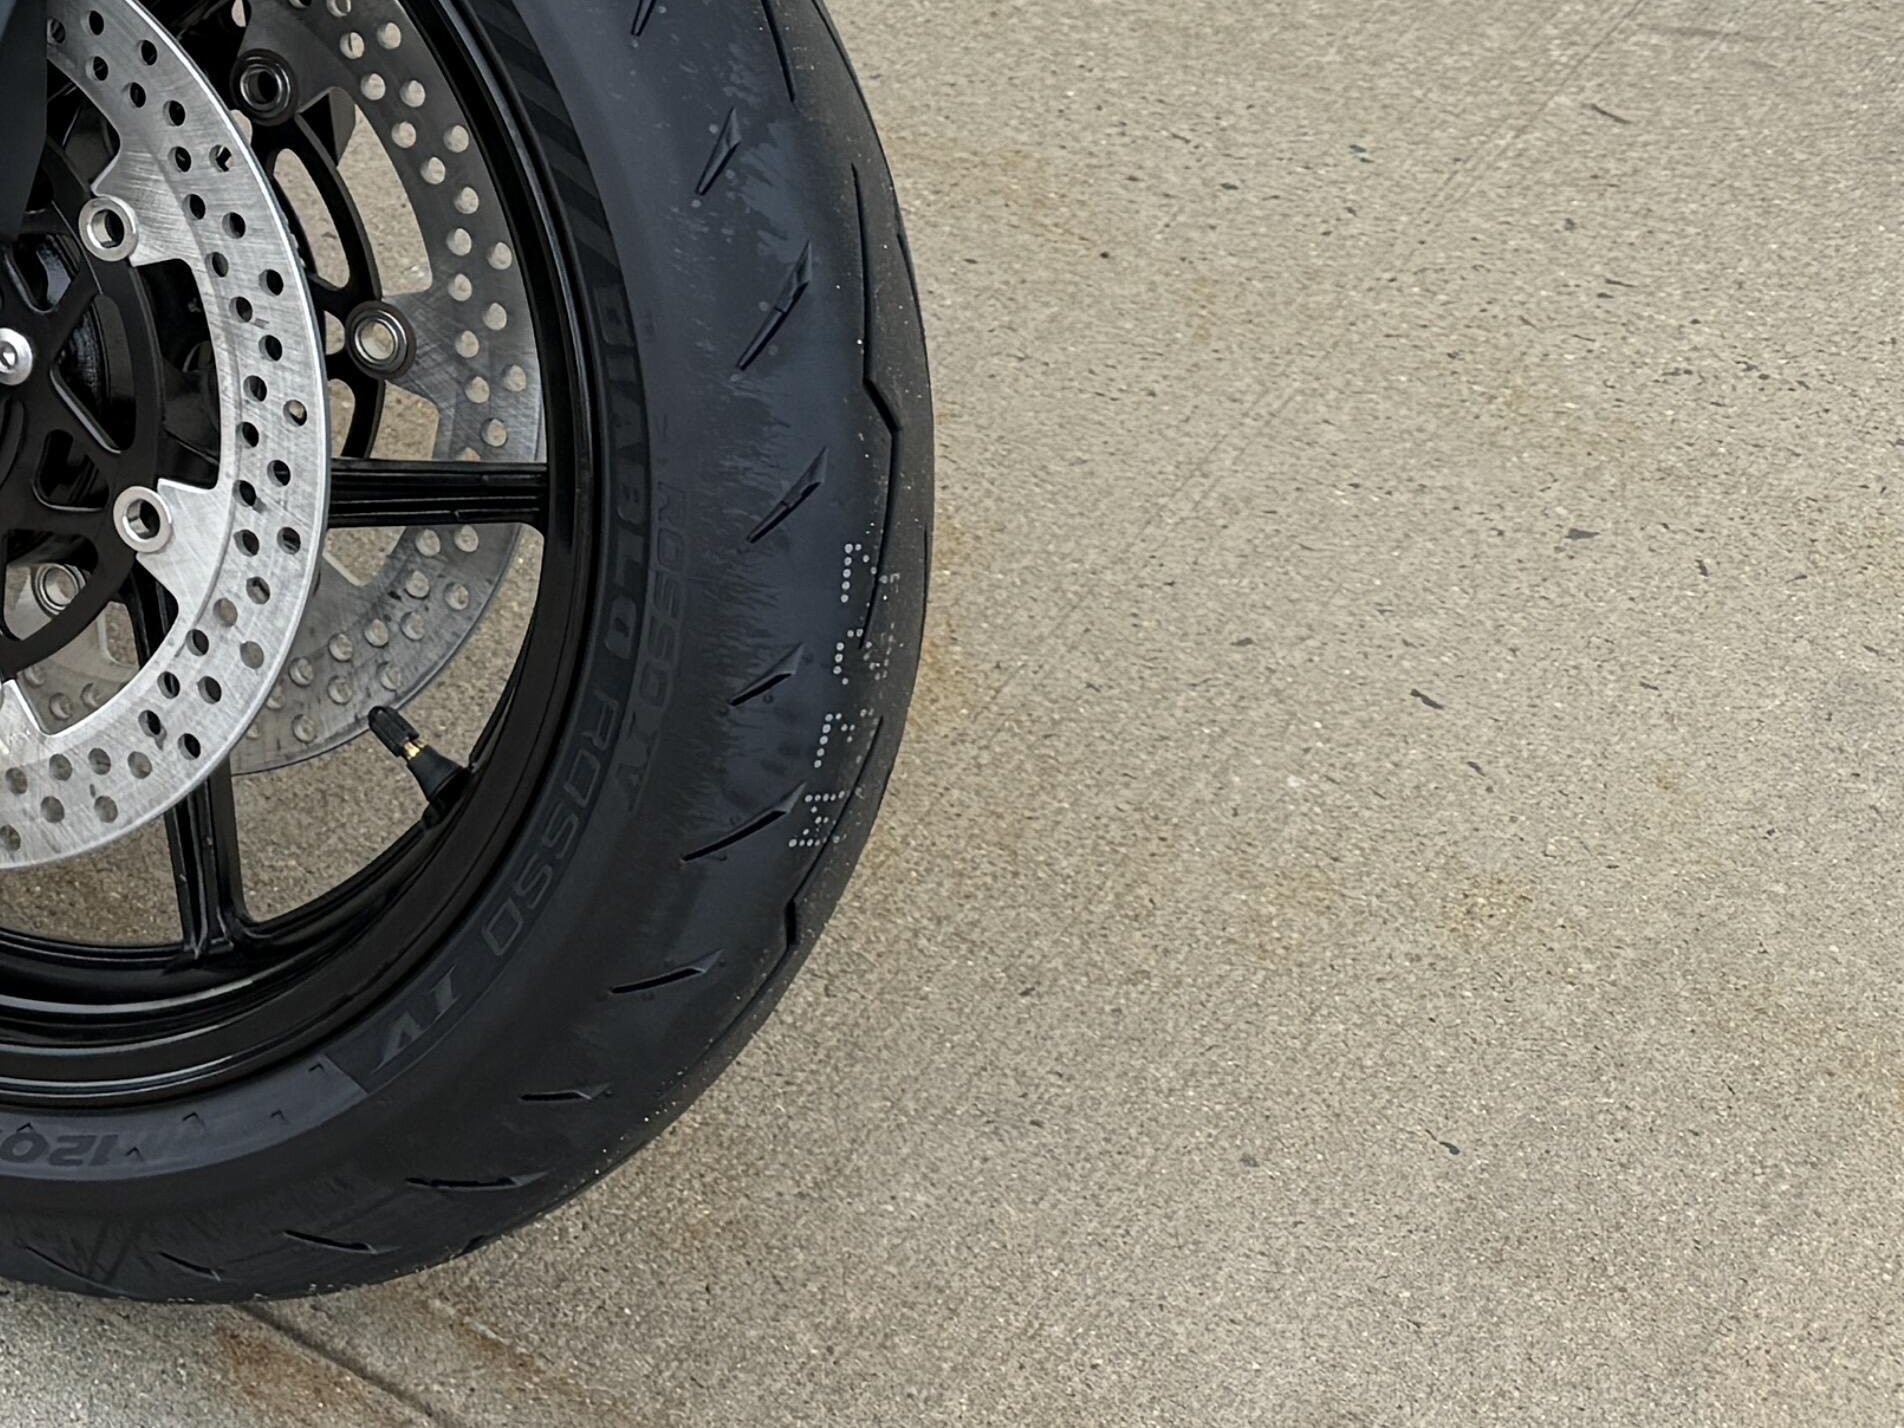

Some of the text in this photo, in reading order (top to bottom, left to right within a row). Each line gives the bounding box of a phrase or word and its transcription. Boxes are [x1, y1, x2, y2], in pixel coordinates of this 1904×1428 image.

[369, 282, 646, 1076] DIABLO ROSSO IV
[638, 480, 689, 708] ROSSO
